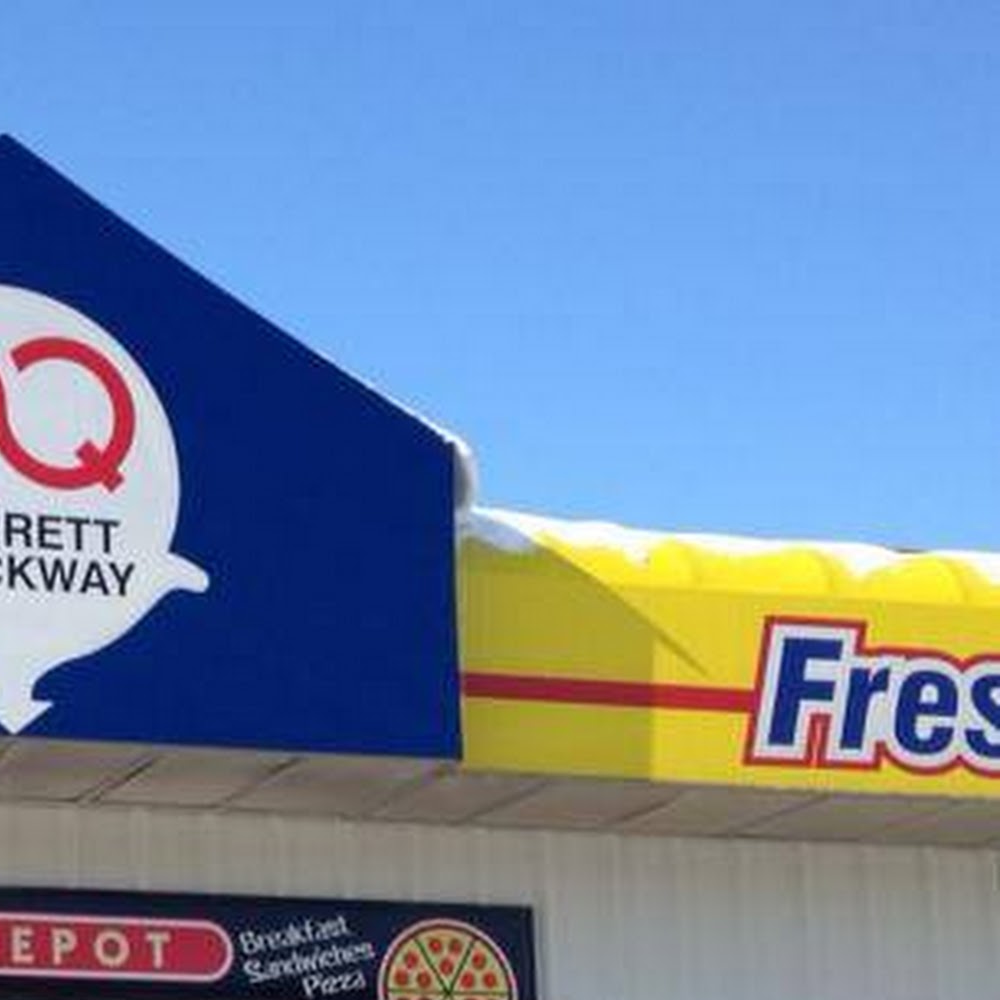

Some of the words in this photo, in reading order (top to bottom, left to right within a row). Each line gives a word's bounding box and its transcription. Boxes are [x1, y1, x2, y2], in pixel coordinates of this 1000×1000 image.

[756, 626, 1000, 768] Fres
[239, 914, 349, 954] Breakfast
[242, 942, 376, 984] Sandwiches
[301, 968, 367, 1000] Pizza
